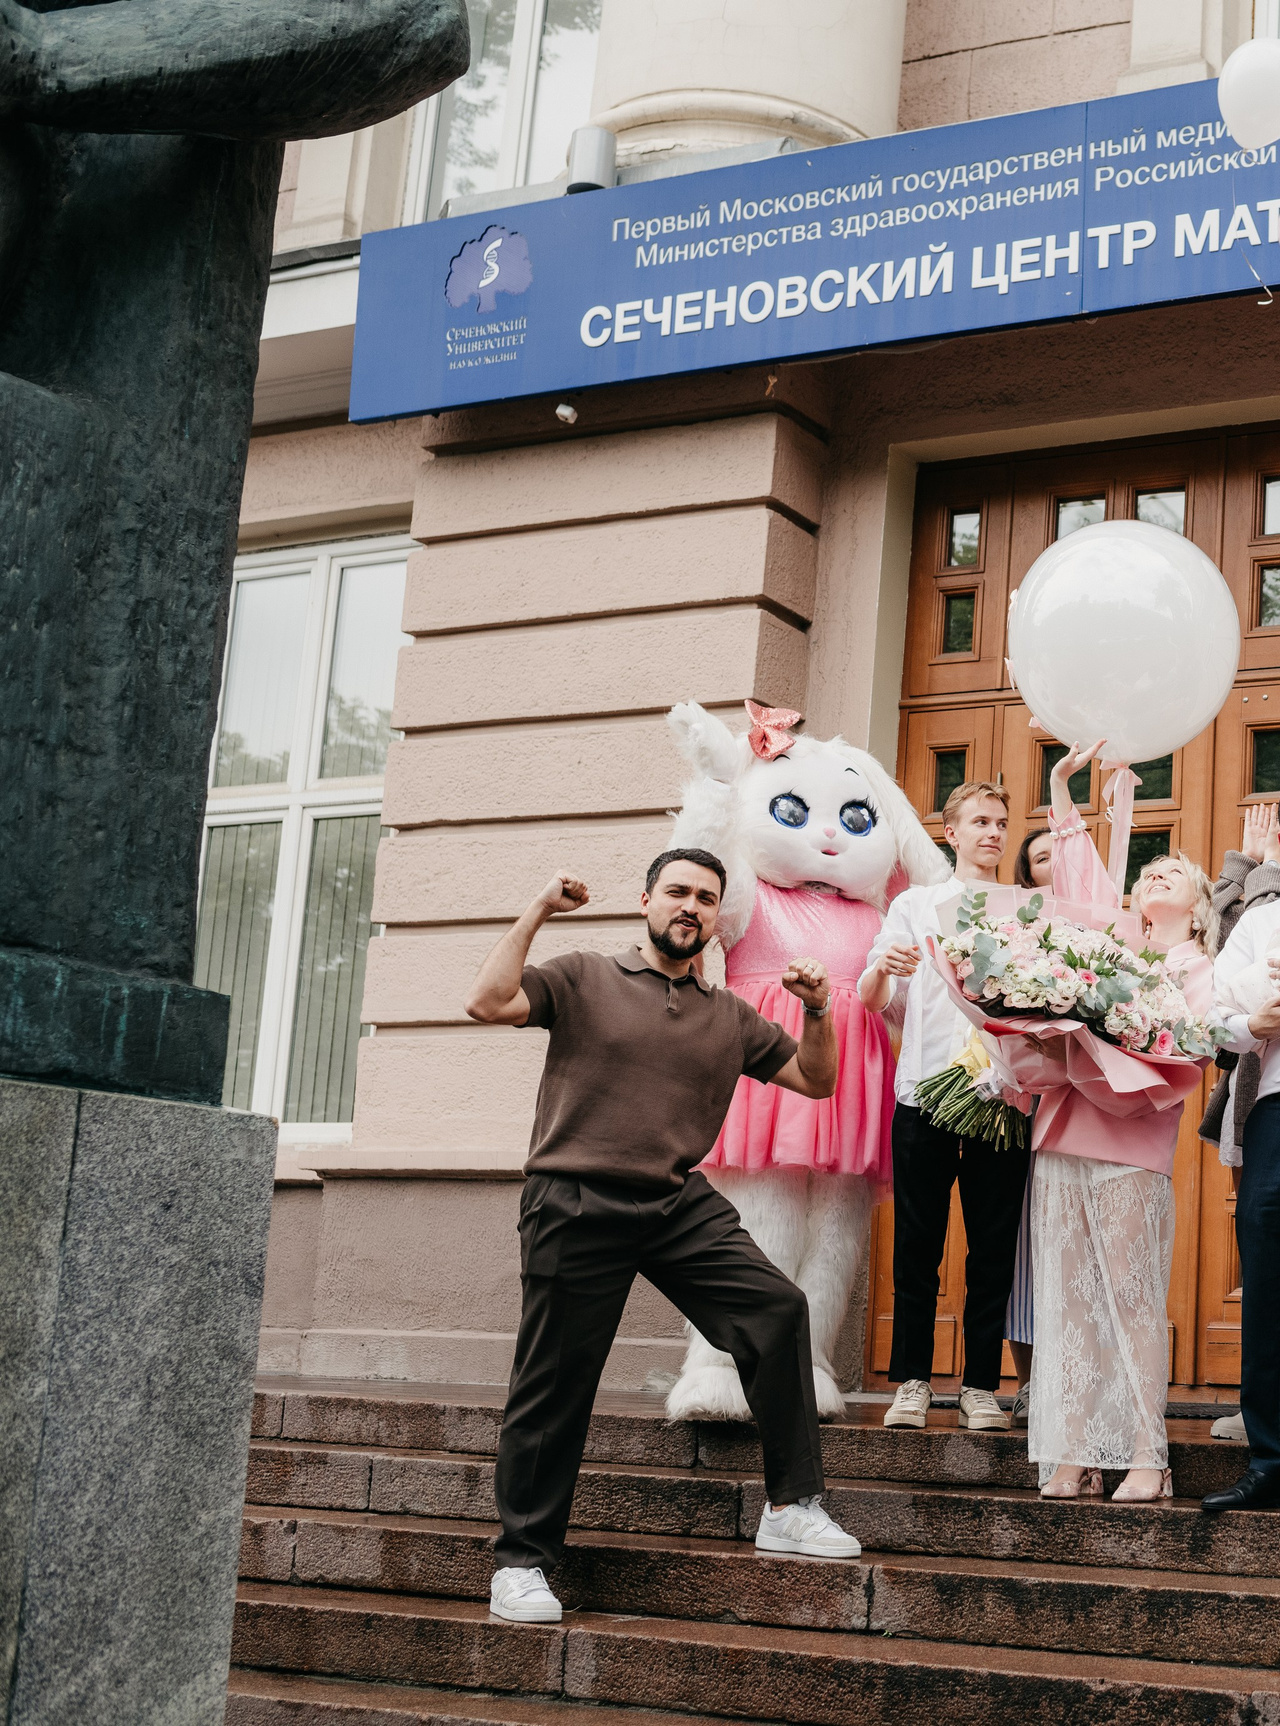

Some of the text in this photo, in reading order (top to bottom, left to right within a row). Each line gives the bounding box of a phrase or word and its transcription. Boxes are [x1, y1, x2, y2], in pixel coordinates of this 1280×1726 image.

[612, 203, 711, 242] Первый
[719, 174, 883, 225] Московский
[891, 127, 1147, 193] государственный
[635, 220, 822, 268] Министерства
[830, 177, 1079, 239] здравоохранения
[1094, 145, 1277, 191] Российской
[580, 242, 954, 348] СЕЧЕНОВСКИЙ
[970, 220, 1157, 295] ЦЕНТР
